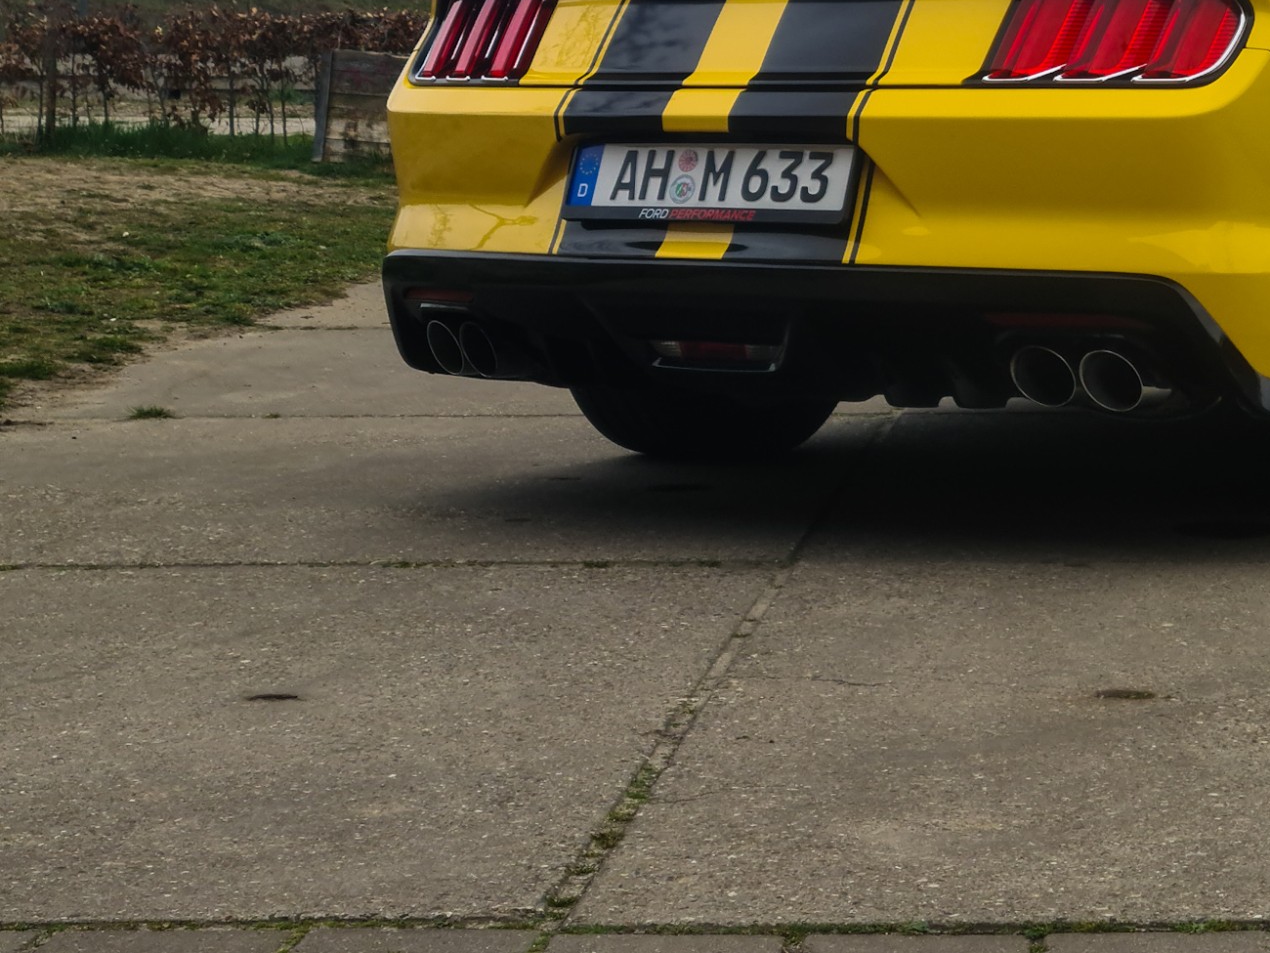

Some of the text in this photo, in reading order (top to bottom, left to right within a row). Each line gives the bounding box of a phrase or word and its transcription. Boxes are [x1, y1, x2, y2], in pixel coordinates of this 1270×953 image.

[609, 149, 835, 204] AH M 633
[577, 183, 589, 198] D
[638, 208, 756, 221] FORD PERFORMANCE
